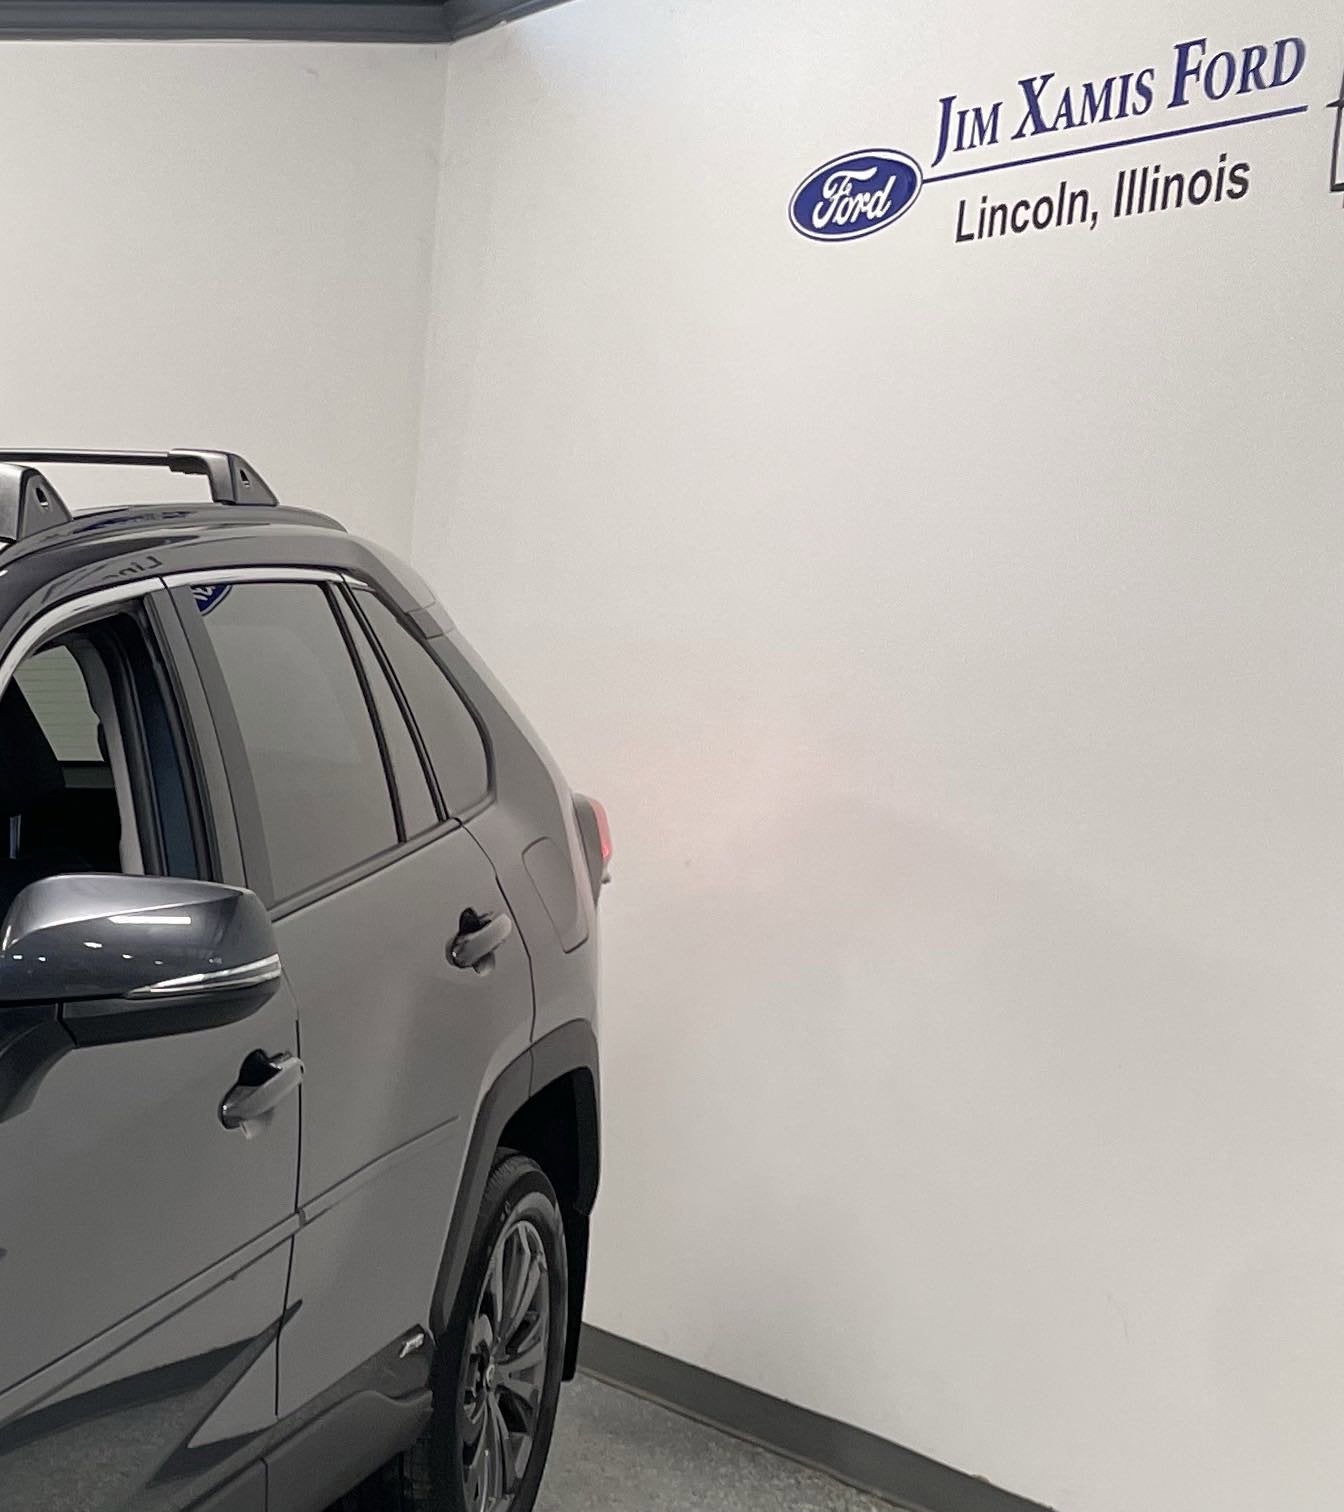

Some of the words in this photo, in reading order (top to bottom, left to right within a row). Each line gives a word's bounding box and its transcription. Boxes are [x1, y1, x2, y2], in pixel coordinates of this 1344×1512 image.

[931, 95, 1002, 168] JIM
[1011, 68, 1155, 139] XAMIS
[1168, 37, 1307, 109] FORD
[812, 167, 899, 230] Ford
[956, 182, 1098, 243] Lincoln,
[1113, 153, 1251, 218] Illinois
